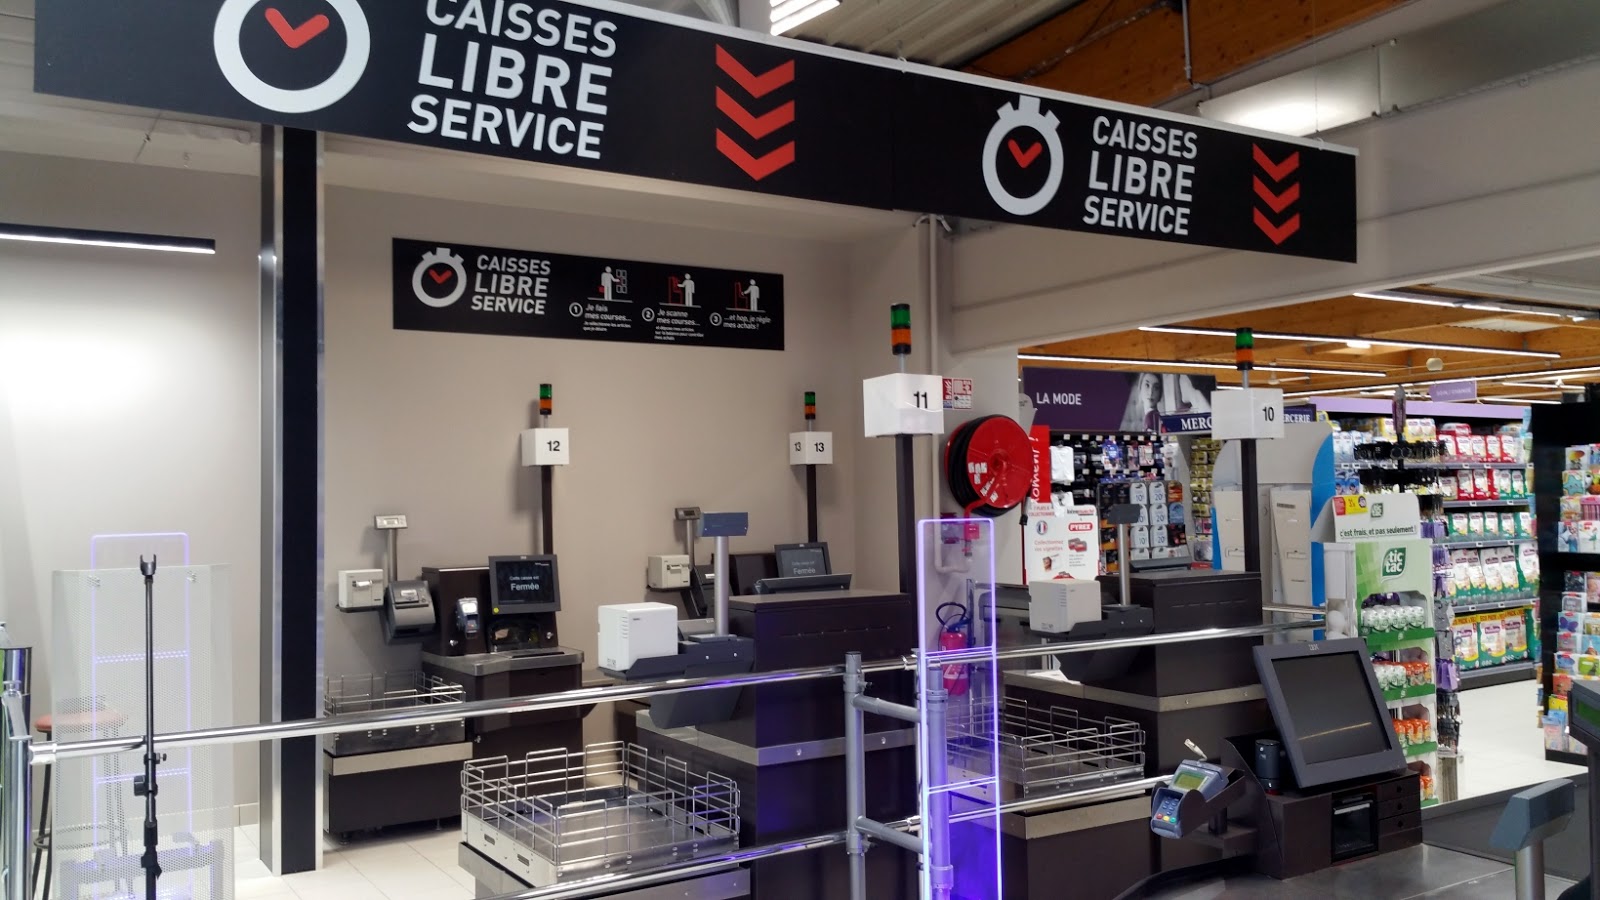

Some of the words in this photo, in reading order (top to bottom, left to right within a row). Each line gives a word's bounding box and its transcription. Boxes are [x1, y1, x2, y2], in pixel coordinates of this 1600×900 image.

[425, 0, 617, 58] CAISSES
[417, 33, 613, 115] LIBRE
[407, 95, 605, 159] SERVICE
[1092, 116, 1198, 159] CAISSES
[1088, 151, 1196, 202] LIBRE
[1082, 197, 1191, 236] SERVICE
[476, 255, 551, 275] CAISSES
[474, 273, 549, 297] LIBRE
[471, 295, 546, 315] SERVICE
[585, 303, 594, 311] Je
[595, 304, 608, 312] fais
[657, 308, 665, 316] Je
[666, 310, 688, 318] scanne
[913, 391, 928, 409] 11
[1036, 391, 1050, 404] LA
[1052, 393, 1082, 406] MODE
[1263, 406, 1275, 422] 10
[1284, 414, 1311, 423] ERCERIE
[1181, 416, 1212, 431] MERC
[547, 440, 560, 452] 12
[794, 441, 801, 452] 13
[814, 442, 825, 453] 13
[1070, 523, 1091, 531] PYREX
[1375, 528, 1385, 536] pas
[1389, 550, 1403, 562] tic
[793, 567, 816, 575] Fermée
[1385, 562, 1403, 573] tac
[510, 582, 540, 591] Fermée
[1308, 643, 1320, 651] IBM
